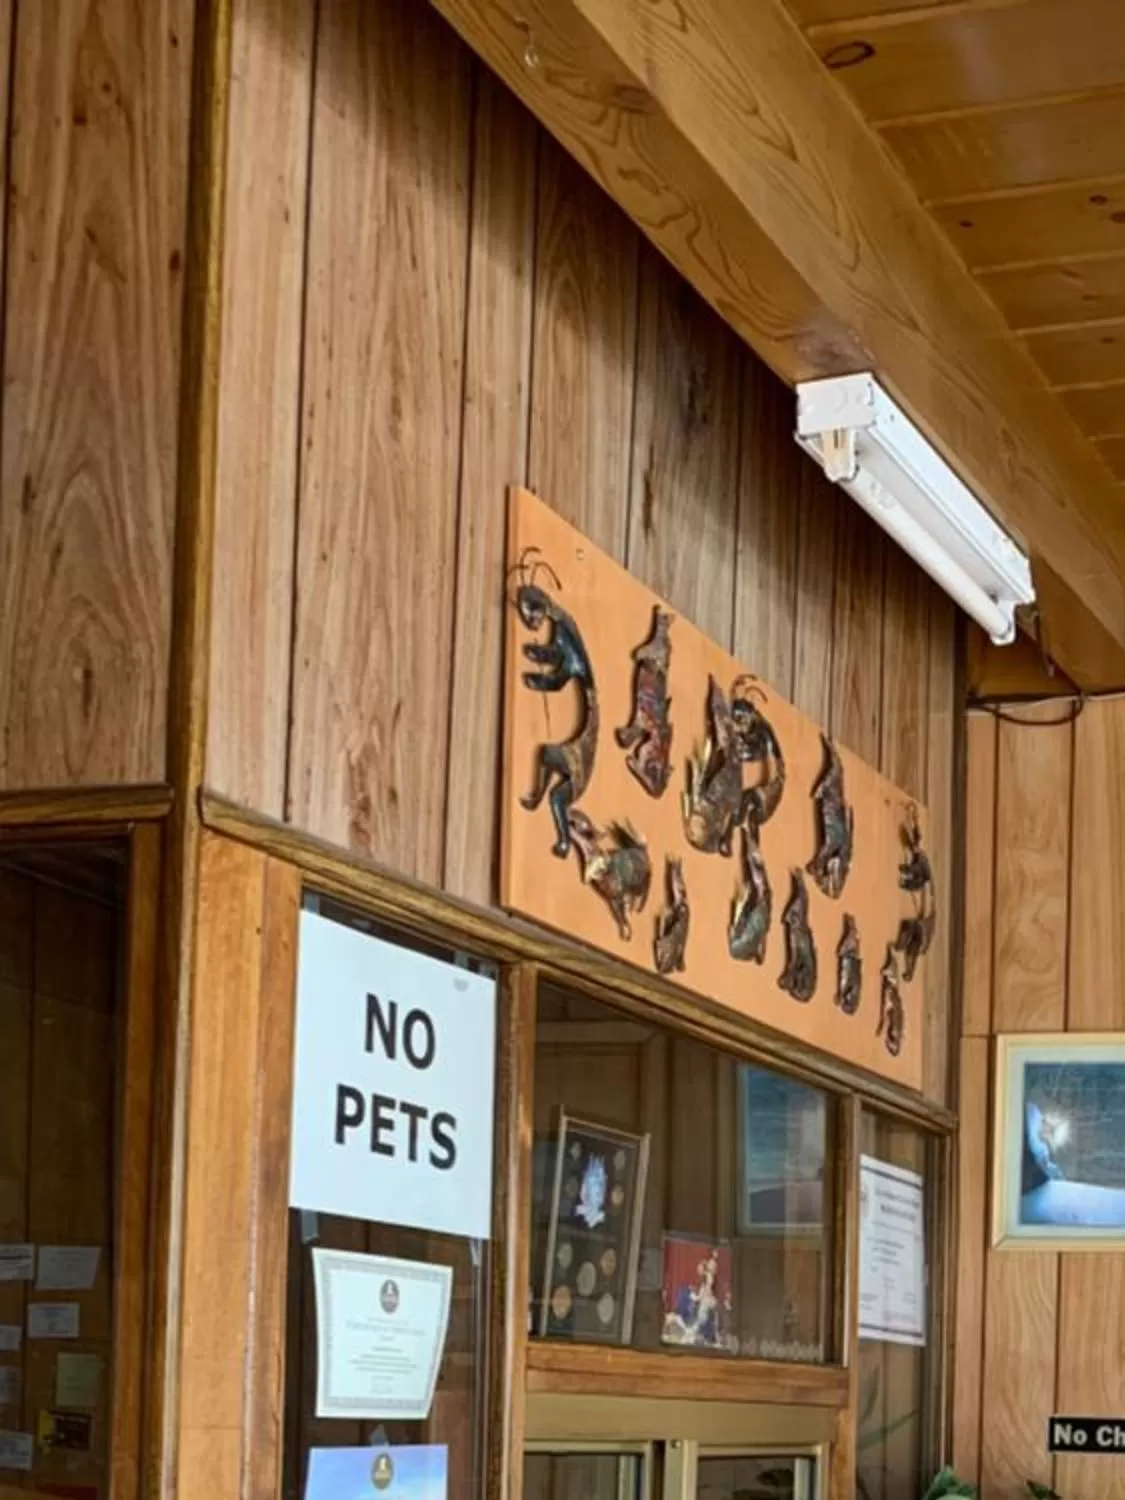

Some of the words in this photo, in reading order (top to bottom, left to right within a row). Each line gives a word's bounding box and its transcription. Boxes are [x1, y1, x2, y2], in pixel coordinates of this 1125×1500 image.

[364, 991, 437, 1071] NO
[334, 1082, 457, 1171] PETS
[1053, 1423, 1088, 1446] No
